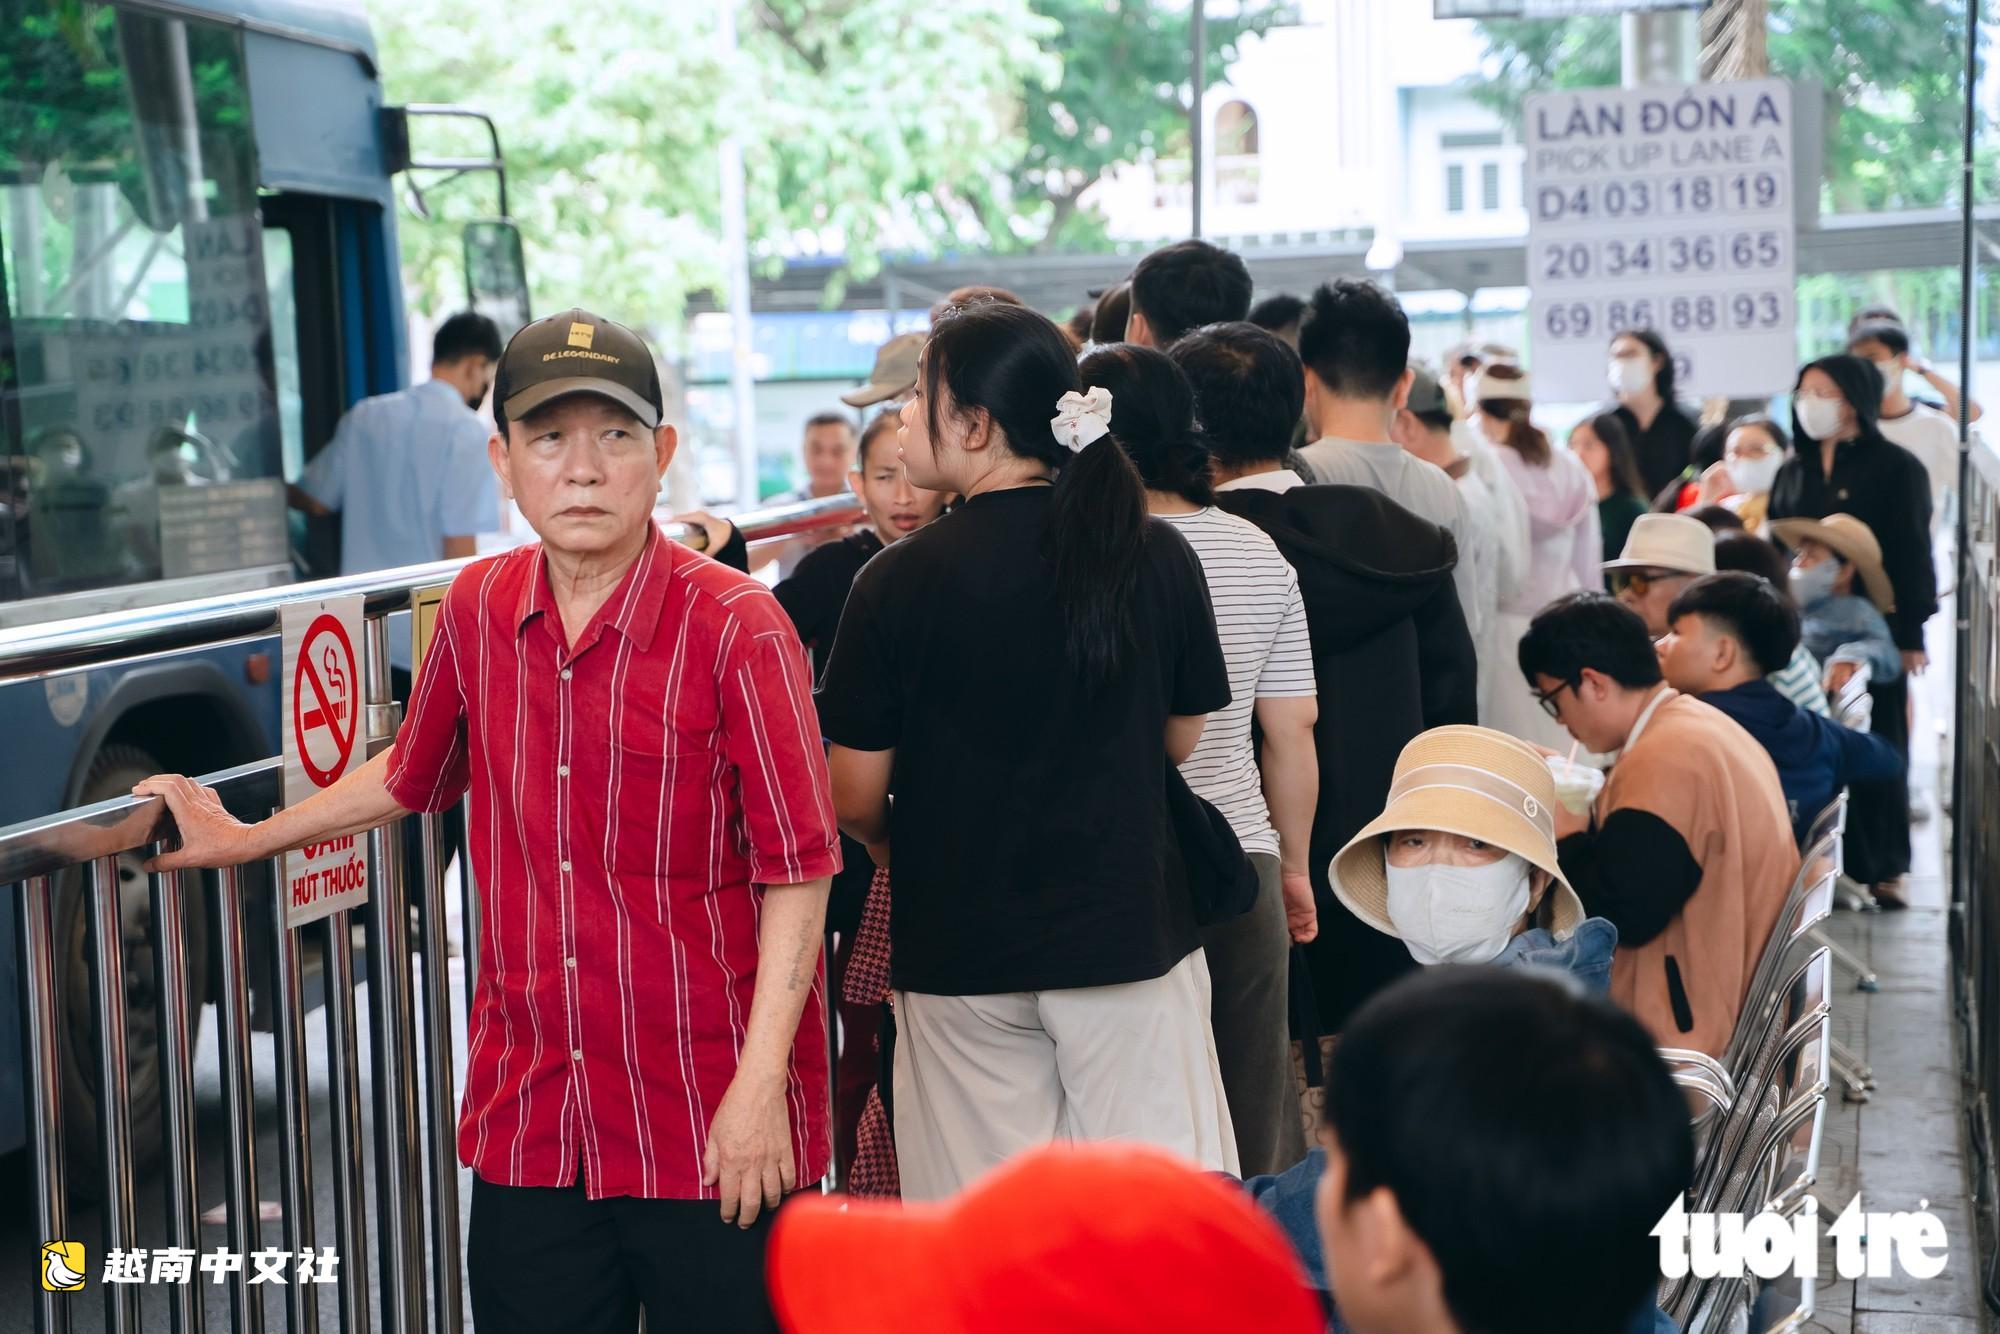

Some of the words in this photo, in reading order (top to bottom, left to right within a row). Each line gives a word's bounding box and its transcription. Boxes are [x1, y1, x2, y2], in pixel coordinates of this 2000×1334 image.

[1537, 97, 1624, 142] LÀN
[1640, 88, 1736, 135] ĐÓN
[1751, 92, 1781, 127] A
[1536, 146, 1610, 174] PICK
[1618, 142, 1662, 171] UP
[1671, 135, 1751, 168] LANE
[1760, 134, 1783, 160] A
[1537, 185, 1590, 221] D4
[1604, 181, 1650, 216] 03
[1669, 176, 1712, 212] 18
[1733, 172, 1776, 207] 19
[1545, 242, 1591, 279] 20
[1607, 239, 1650, 275] 34
[1669, 235, 1715, 272] 36
[1733, 231, 1779, 268] 65
[1546, 302, 1592, 339] 69
[1671, 295, 1716, 332] 88
[1733, 292, 1780, 328] 93
[292, 868, 318, 908] HÚT
[321, 852, 365, 898] THUỐC
